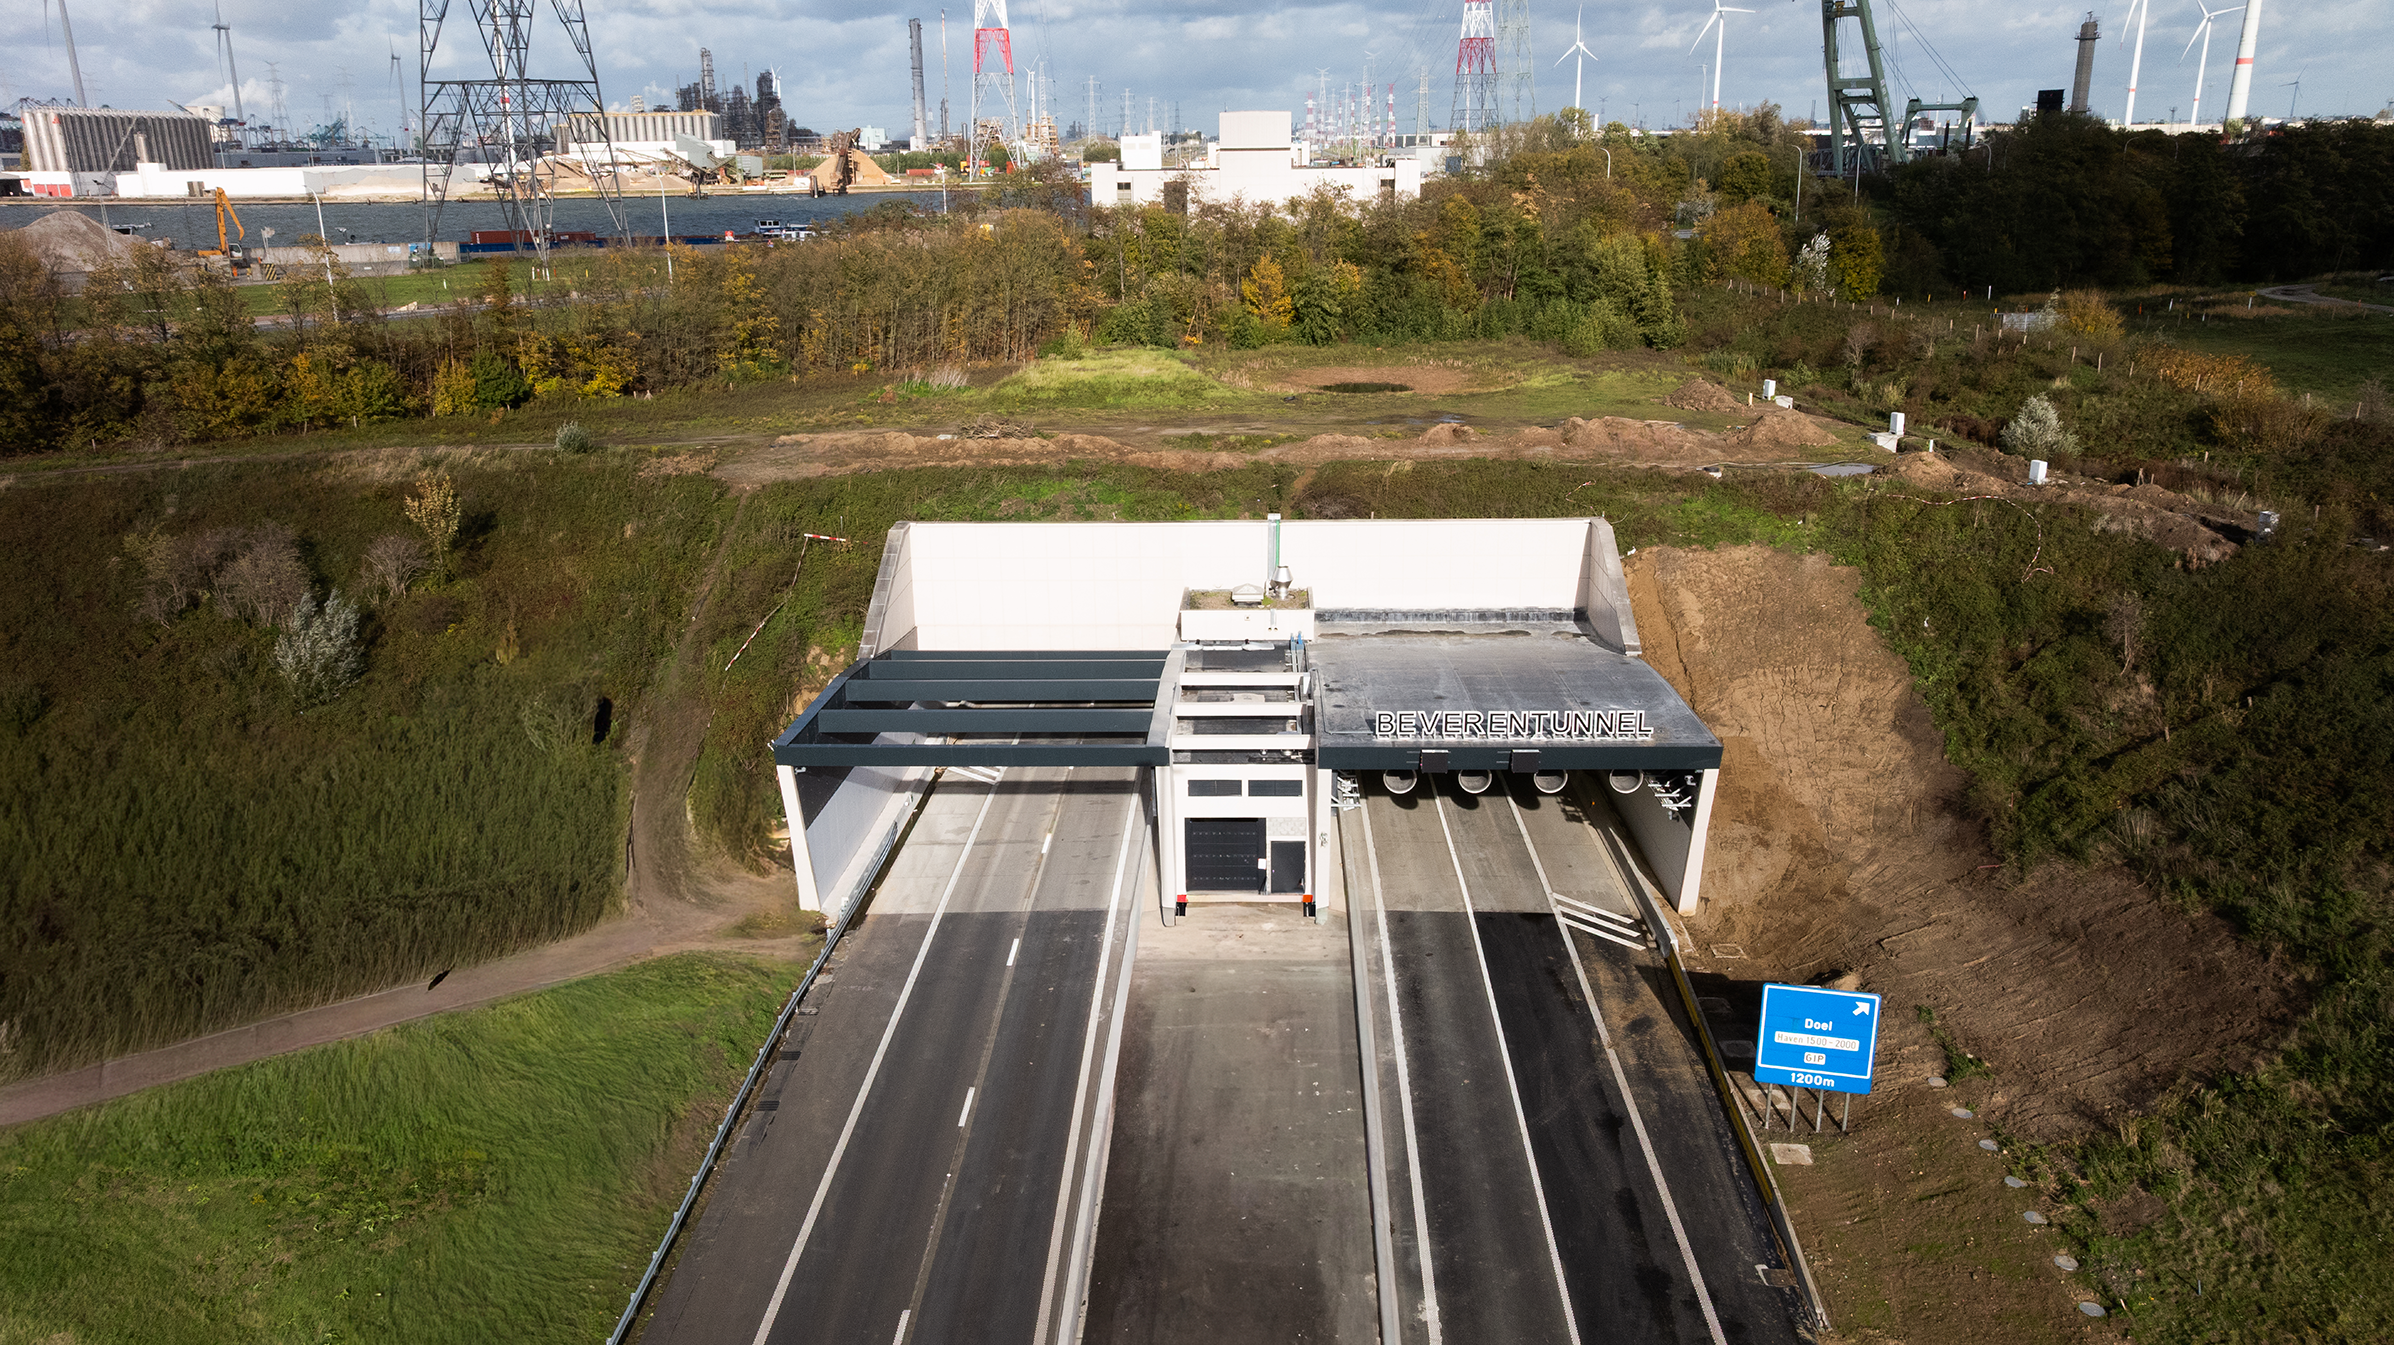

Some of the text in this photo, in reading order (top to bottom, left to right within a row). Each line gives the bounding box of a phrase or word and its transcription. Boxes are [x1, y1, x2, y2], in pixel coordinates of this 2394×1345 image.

[1375, 710, 1654, 736] BEVERENTUNNEL
[1804, 1018, 1833, 1031] Doel
[1777, 1033, 1804, 1044] Haven
[1806, 1036, 1828, 1046] 1500
[1835, 1040, 1857, 1050] 2000
[1805, 1053, 1825, 1064] GIP
[1791, 1072, 1835, 1088] 1200m
